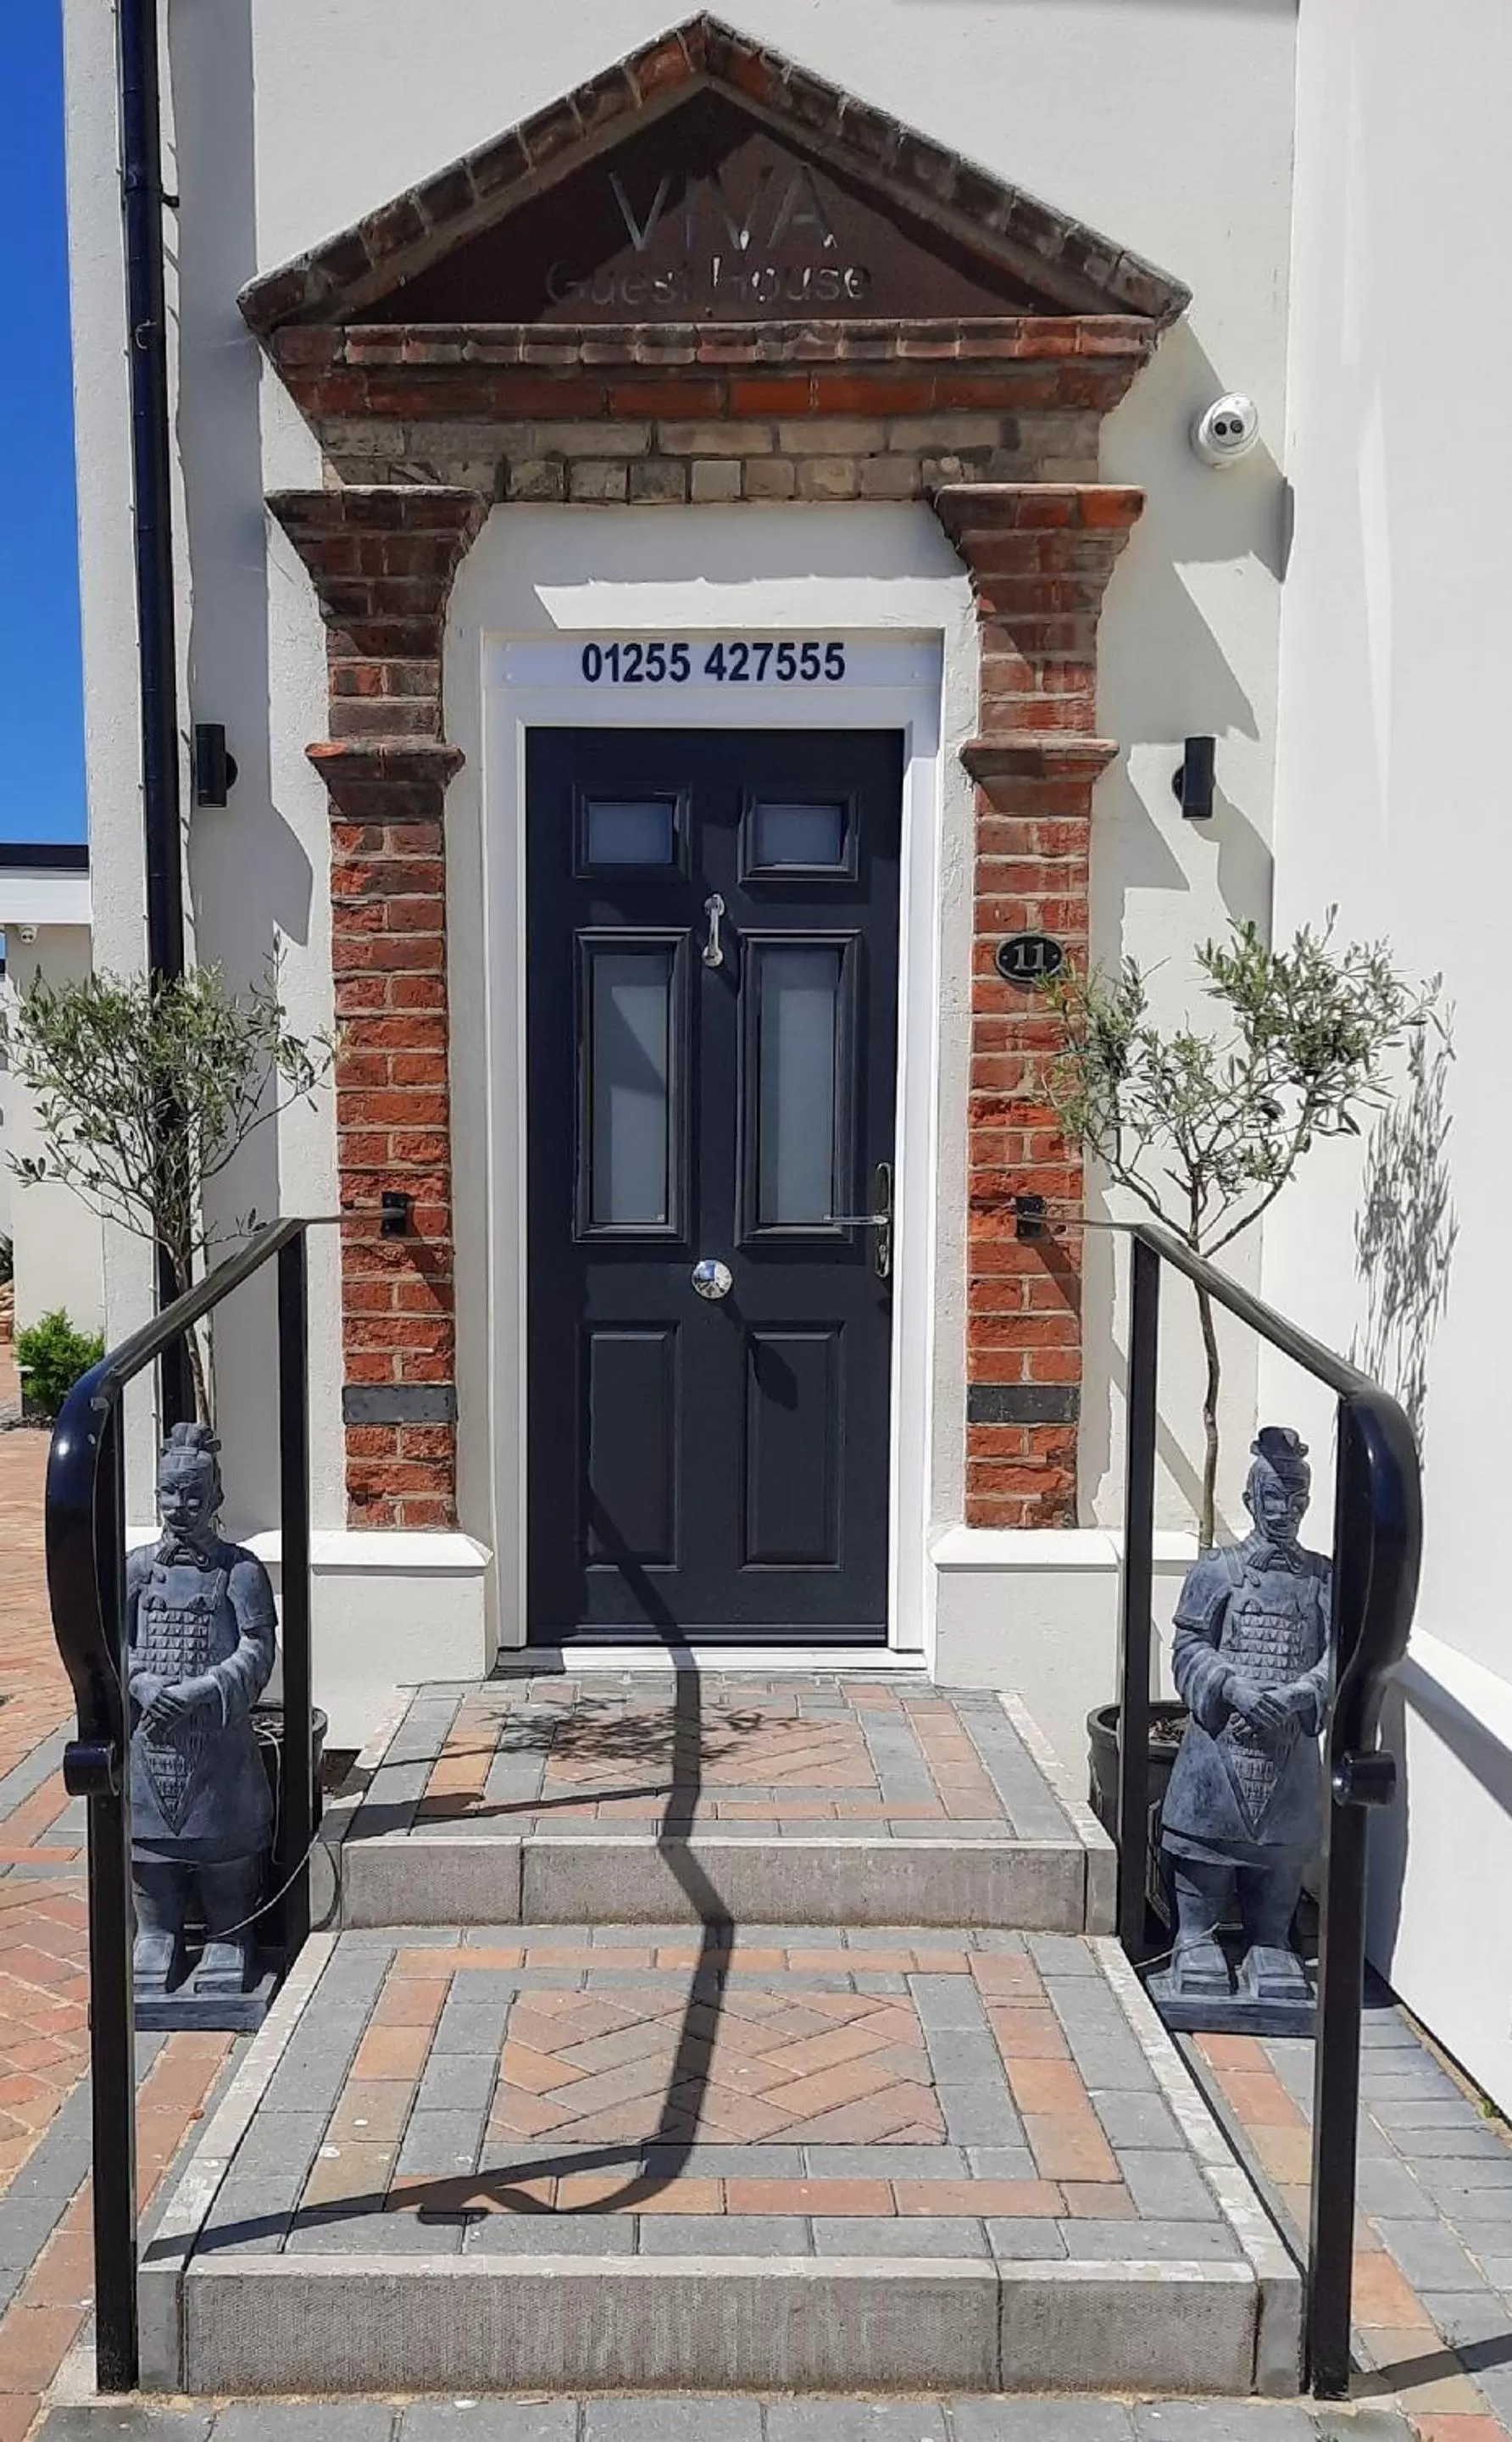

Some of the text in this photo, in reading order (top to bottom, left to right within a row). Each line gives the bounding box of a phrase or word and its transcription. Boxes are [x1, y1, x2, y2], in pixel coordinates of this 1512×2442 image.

[710, 256, 868, 303] House
[581, 642, 846, 682] 01255 427555
[1014, 942, 1046, 970] 11
